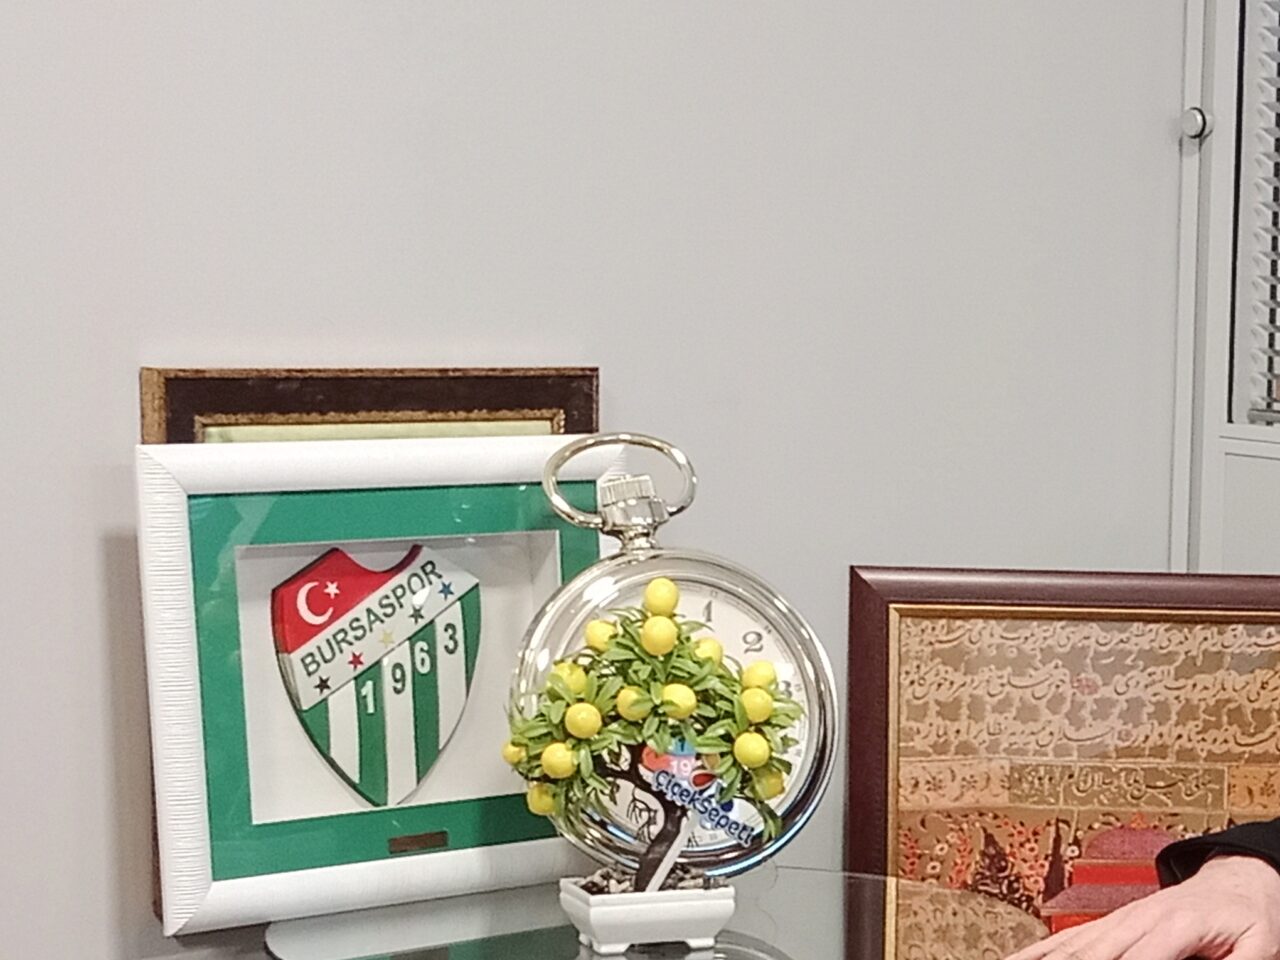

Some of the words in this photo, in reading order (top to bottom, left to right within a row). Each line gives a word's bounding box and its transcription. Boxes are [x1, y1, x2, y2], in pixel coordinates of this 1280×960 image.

[301, 560, 443, 677] BURSASPOR
[742, 631, 764, 654] 2
[361, 622, 459, 714] 1963
